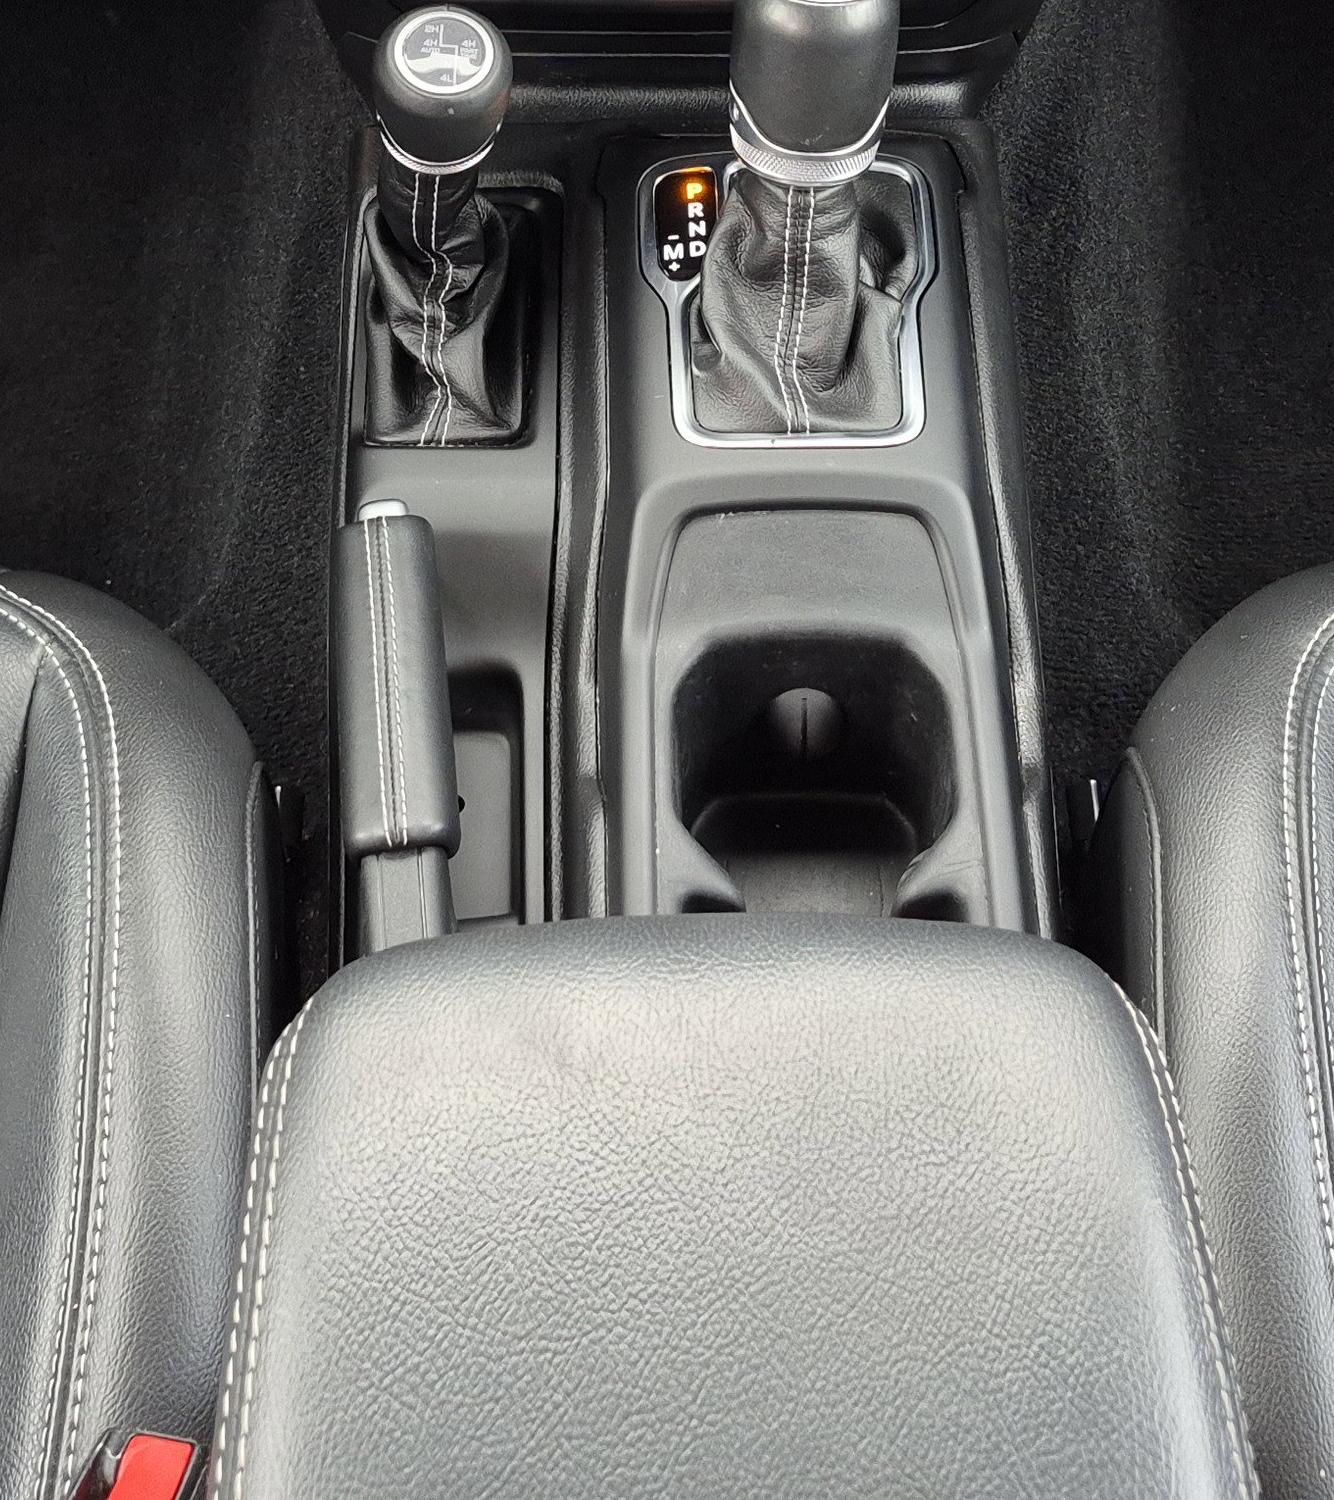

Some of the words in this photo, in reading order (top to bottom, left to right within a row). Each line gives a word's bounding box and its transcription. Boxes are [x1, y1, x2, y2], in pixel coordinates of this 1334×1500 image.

[423, 38, 438, 47] 4H
[462, 39, 476, 48] 4H
[439, 73, 453, 83] 4L
[686, 182, 703, 200] P
[687, 202, 704, 219] R
[688, 220, 706, 238] N
[663, 242, 685, 261] M
[689, 240, 707, 258] D
